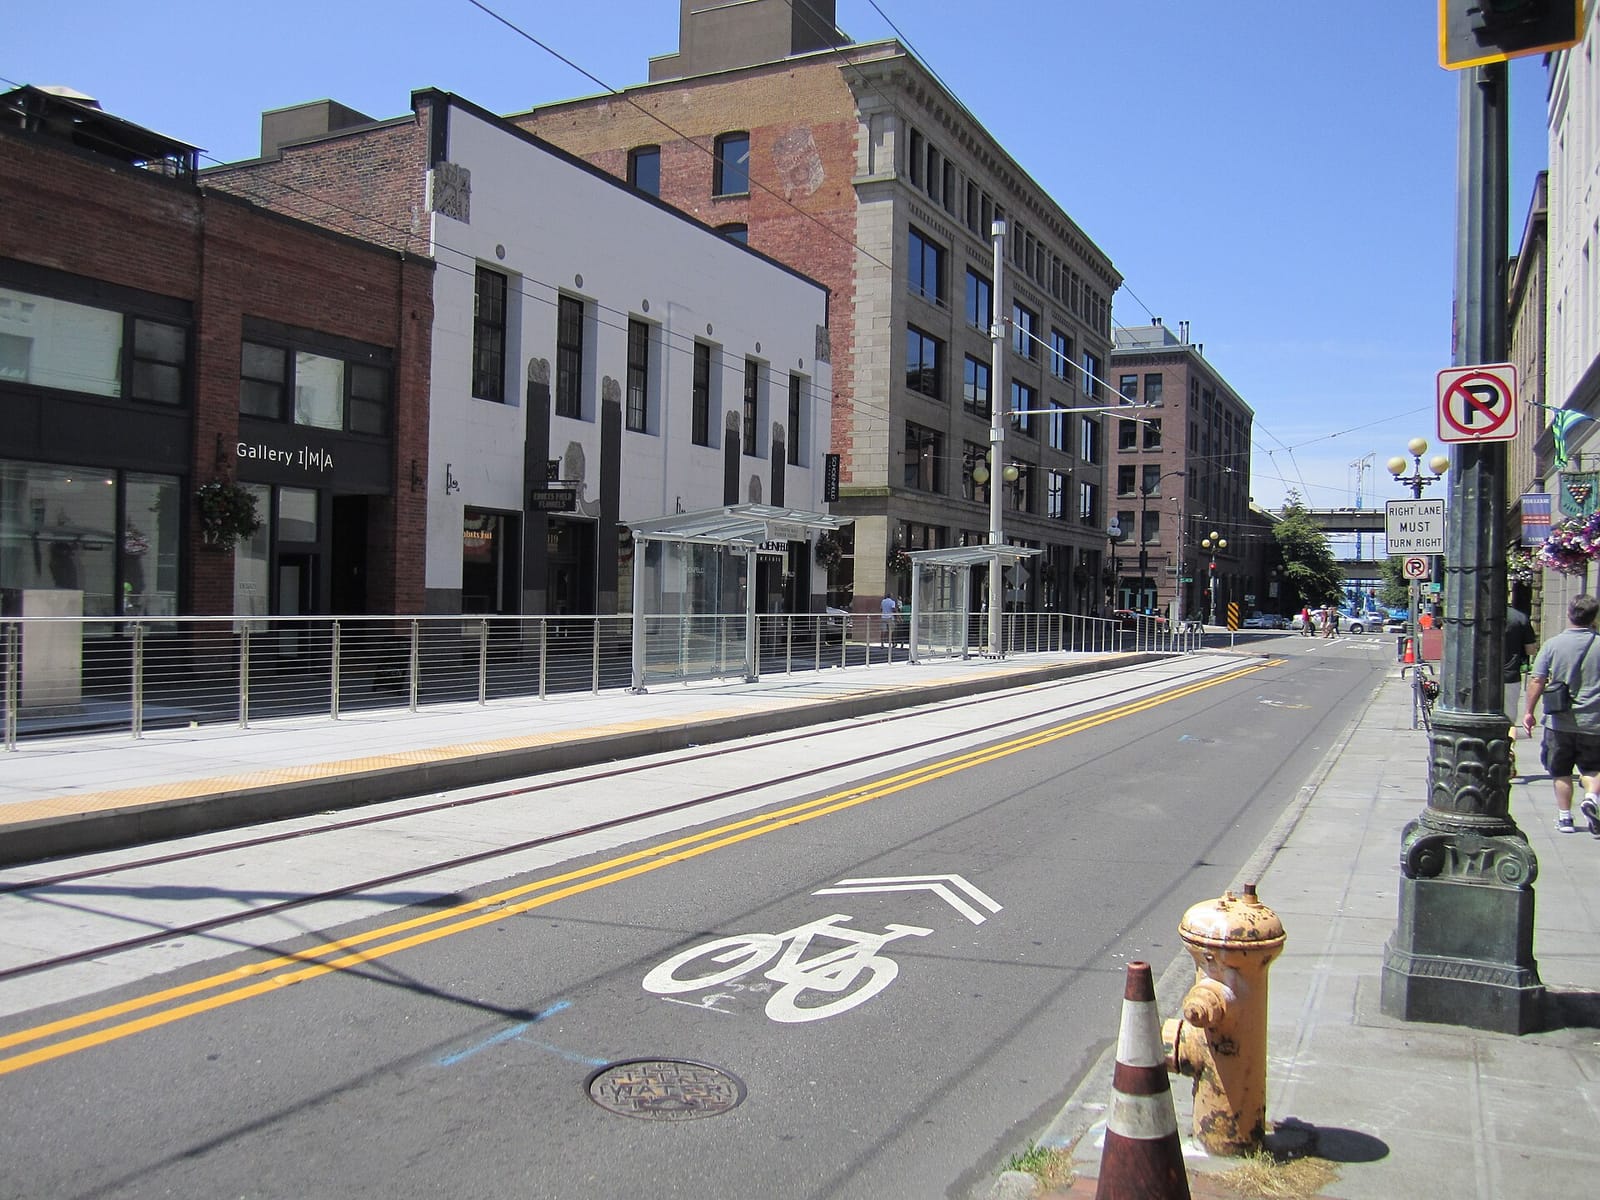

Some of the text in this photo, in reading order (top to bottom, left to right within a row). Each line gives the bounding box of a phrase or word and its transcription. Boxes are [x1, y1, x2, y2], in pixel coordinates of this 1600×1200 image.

[236, 442, 293, 466] Gallery
[1389, 506, 1441, 517] RIGHT LANE
[1399, 521, 1431, 533] MUST
[1389, 537, 1442, 548] TURN RIGHT
[611, 1084, 722, 1098] WATER
